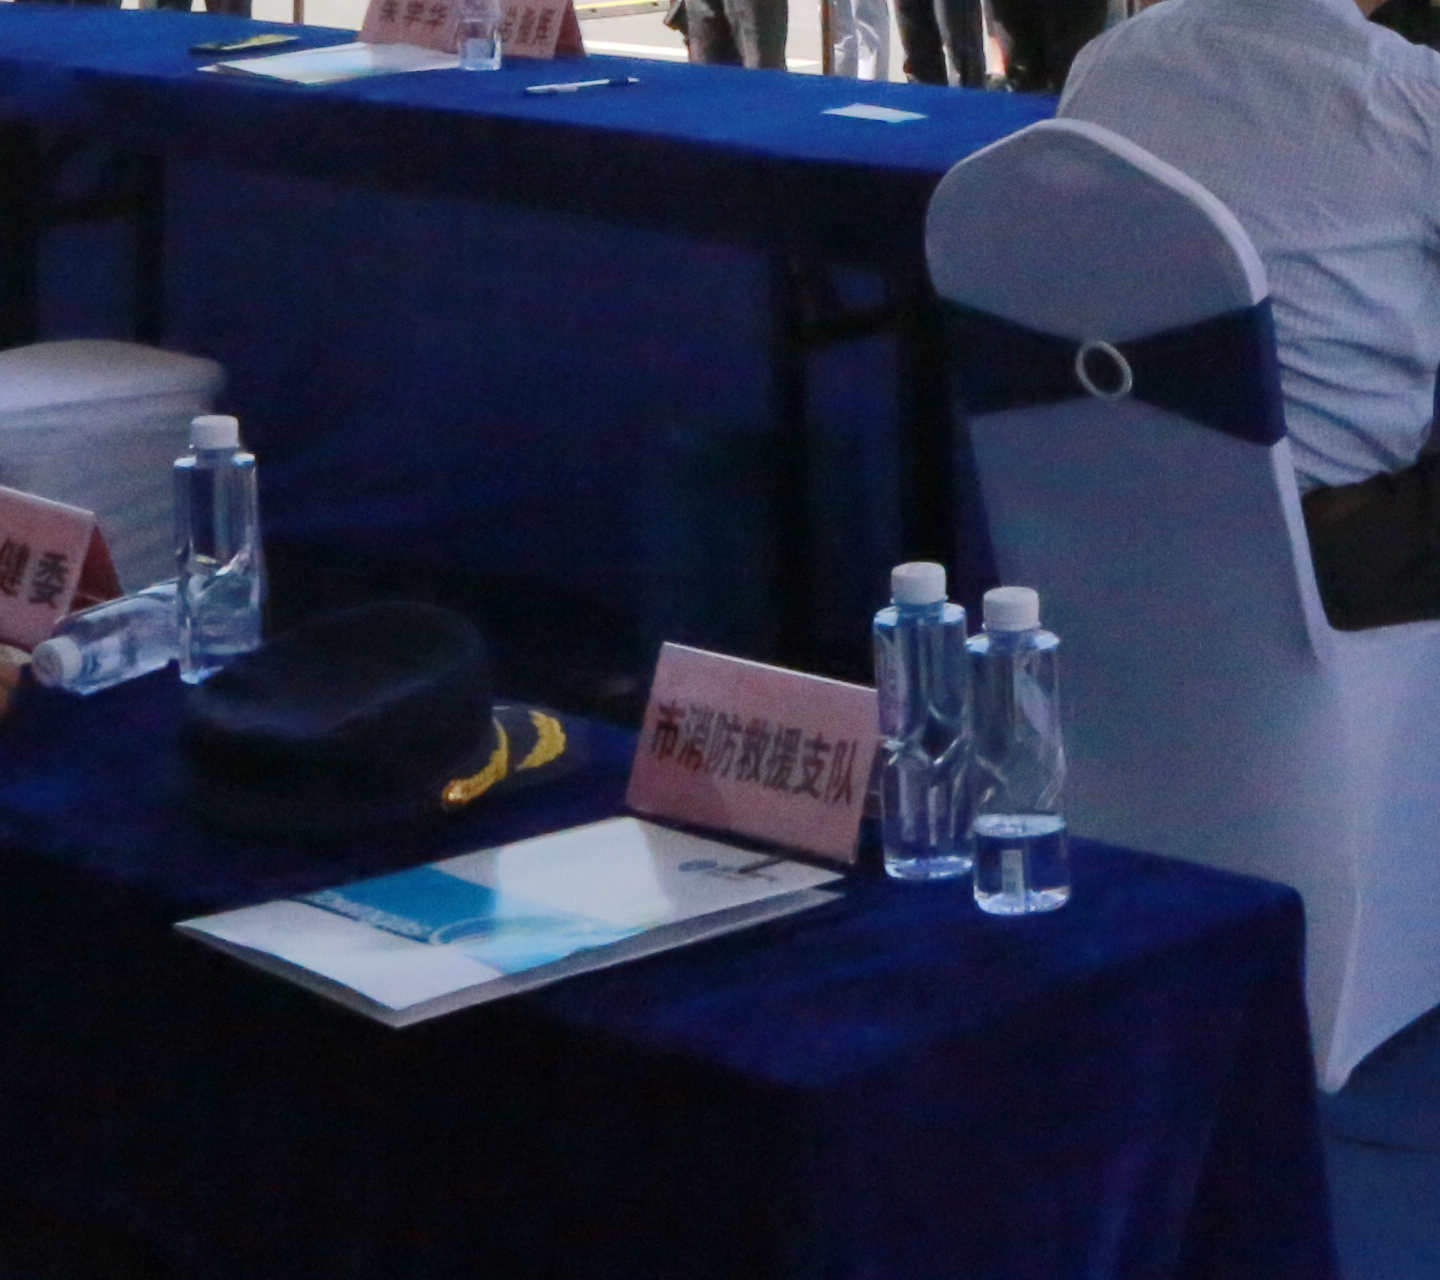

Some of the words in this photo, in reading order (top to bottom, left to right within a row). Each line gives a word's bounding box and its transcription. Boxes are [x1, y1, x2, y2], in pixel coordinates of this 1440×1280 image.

[651, 699, 857, 806] 市消防救援支队
